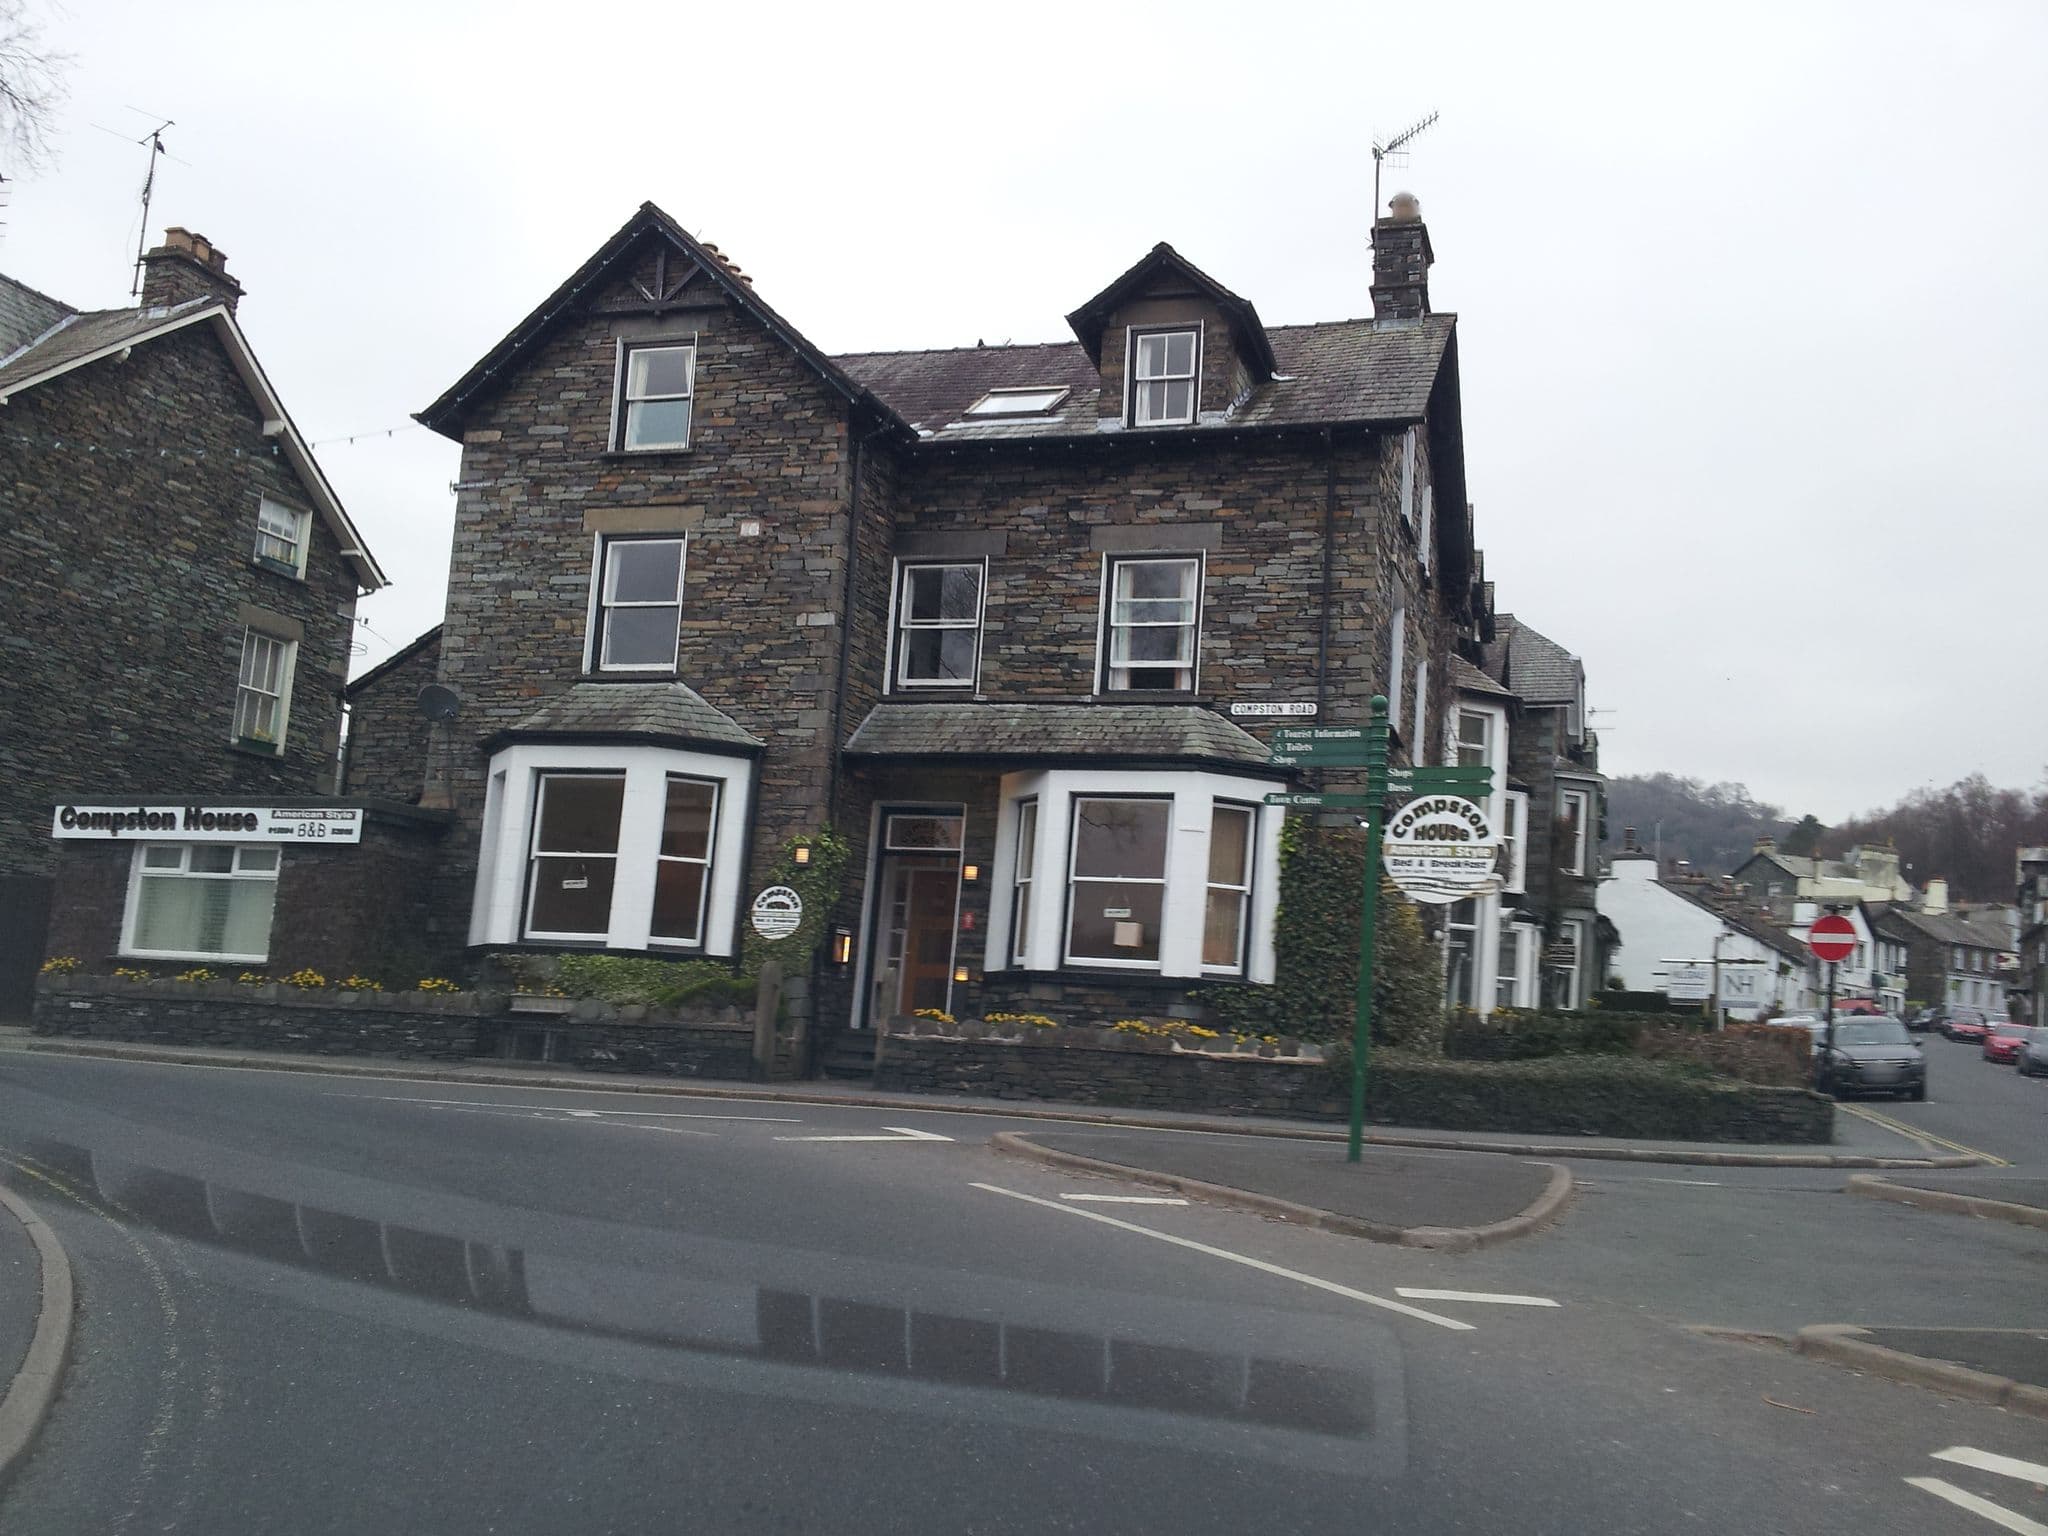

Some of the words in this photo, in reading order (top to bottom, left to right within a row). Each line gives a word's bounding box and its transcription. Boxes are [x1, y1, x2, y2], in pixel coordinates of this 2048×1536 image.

[1233, 704, 1284, 714] COMPSTON
[1289, 704, 1314, 714] ROAD
[1284, 729, 1312, 738] Tourist
[1314, 729, 1362, 738] Information
[1286, 742, 1313, 752] Toilets
[1272, 755, 1297, 766] Shops
[1387, 767, 1414, 779] Shops
[1269, 794, 1292, 804] Town
[1293, 795, 1323, 805] Centre
[273, 810, 324, 819] American
[325, 811, 354, 820] Style
[59, 805, 177, 837] Compston
[183, 806, 258, 832] House
[297, 822, 326, 838] B&B
[1391, 845, 1453, 857] American
[1455, 846, 1492, 858] Style
[1392, 858, 1413, 867] Bed
